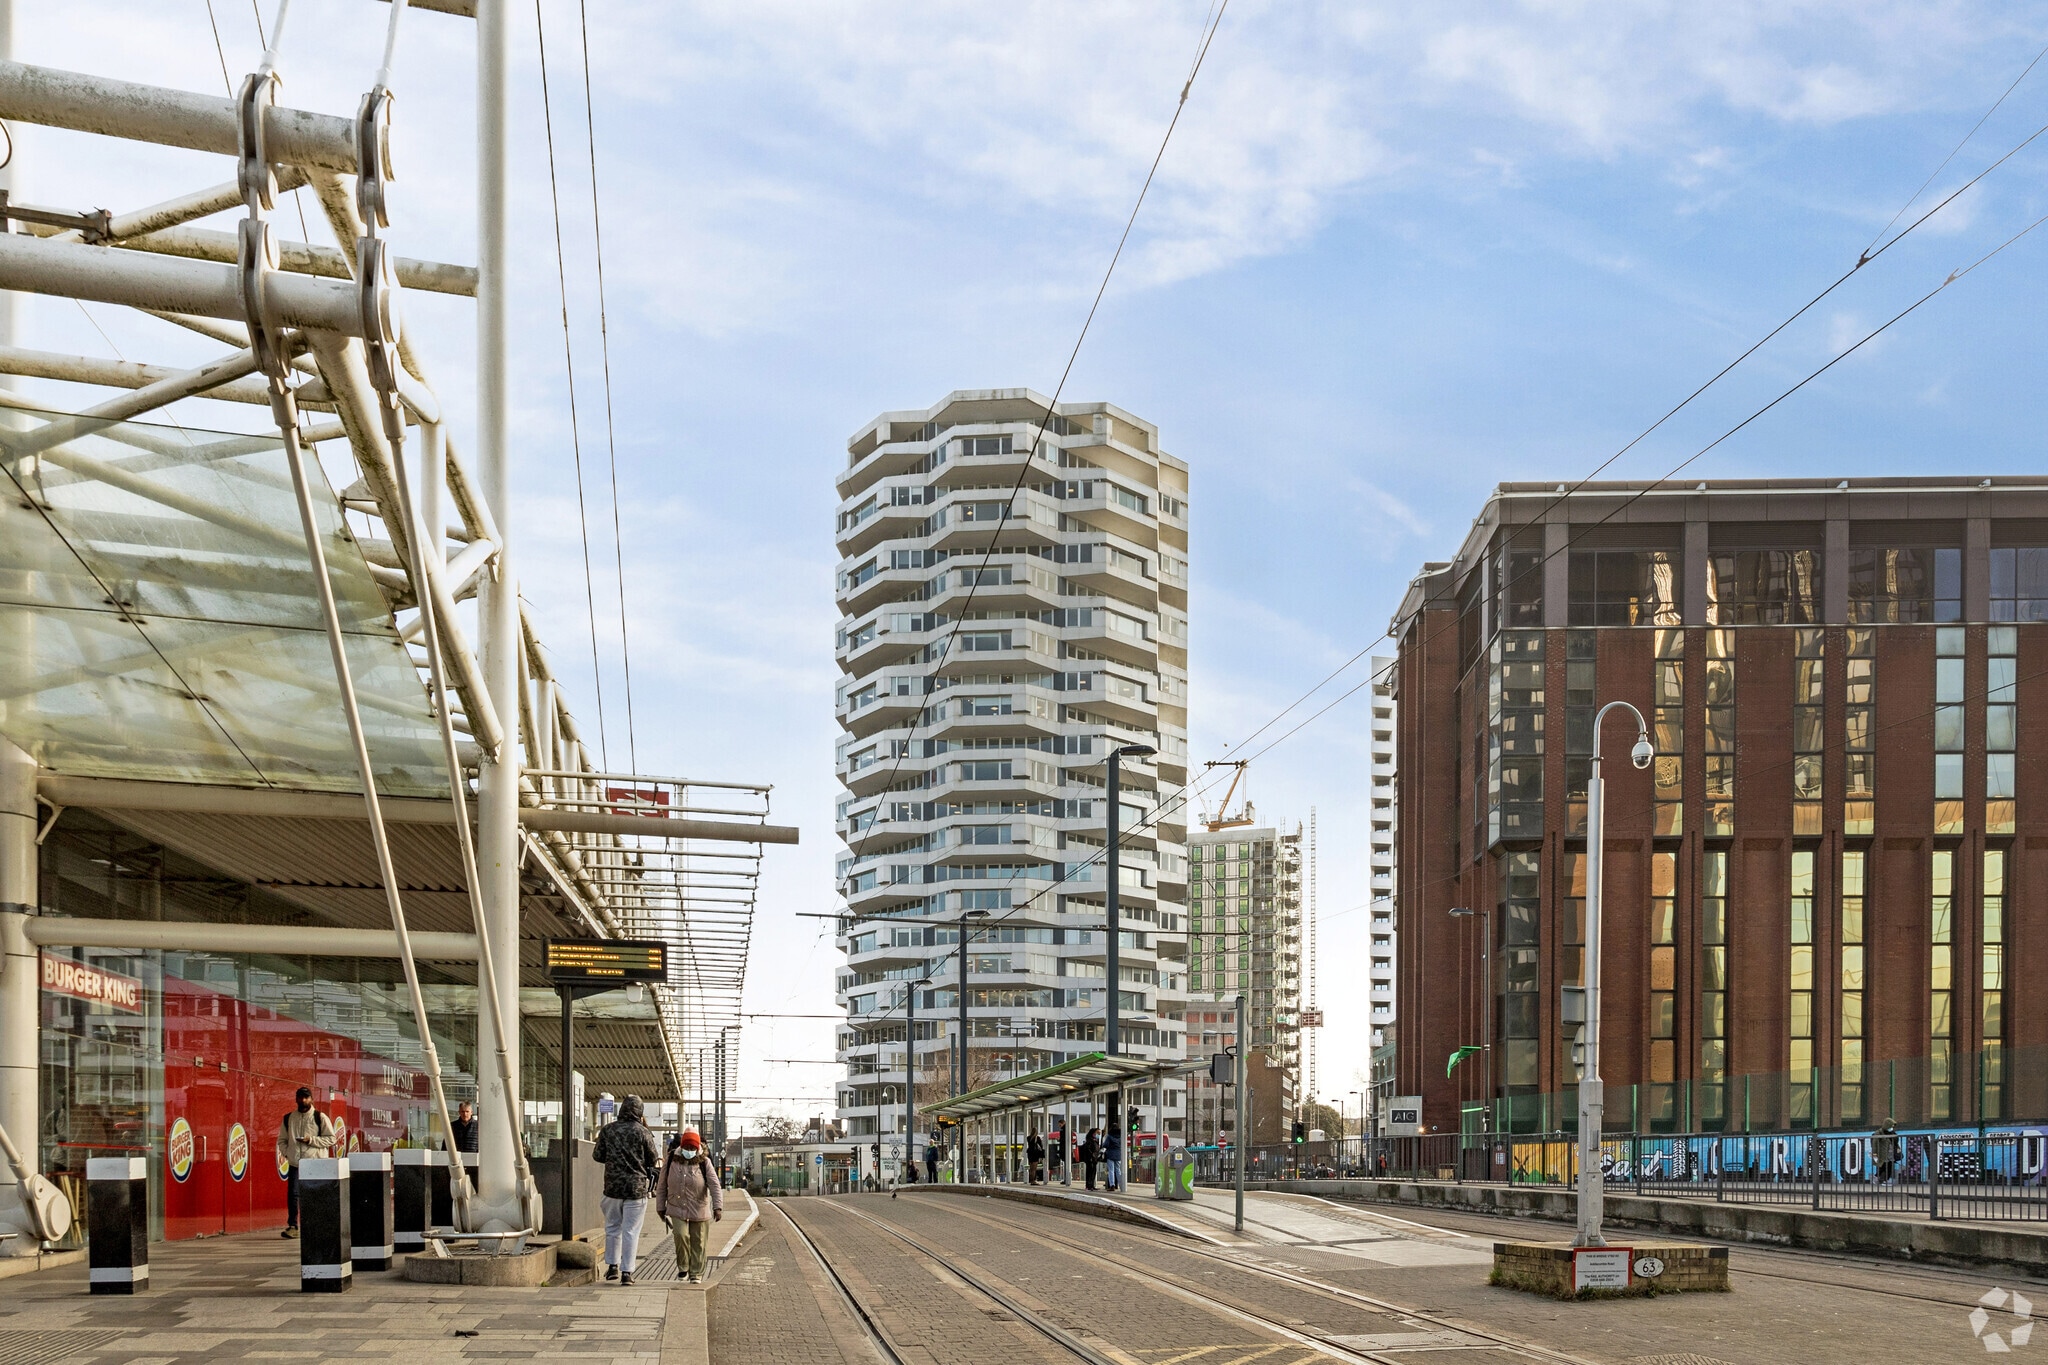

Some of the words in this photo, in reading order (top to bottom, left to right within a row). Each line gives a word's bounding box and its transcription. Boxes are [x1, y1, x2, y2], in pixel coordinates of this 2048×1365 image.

[44, 958, 101, 997] BURGER
[103, 976, 136, 1007] KING
[382, 1064, 414, 1092] TIMPSON
[1394, 1111, 1415, 1121] AIG
[172, 1130, 190, 1152] BURGER
[230, 1134, 246, 1154] BURGER
[172, 1141, 191, 1168] KING
[230, 1144, 246, 1169] KING
[1642, 1262, 1656, 1273] 63
